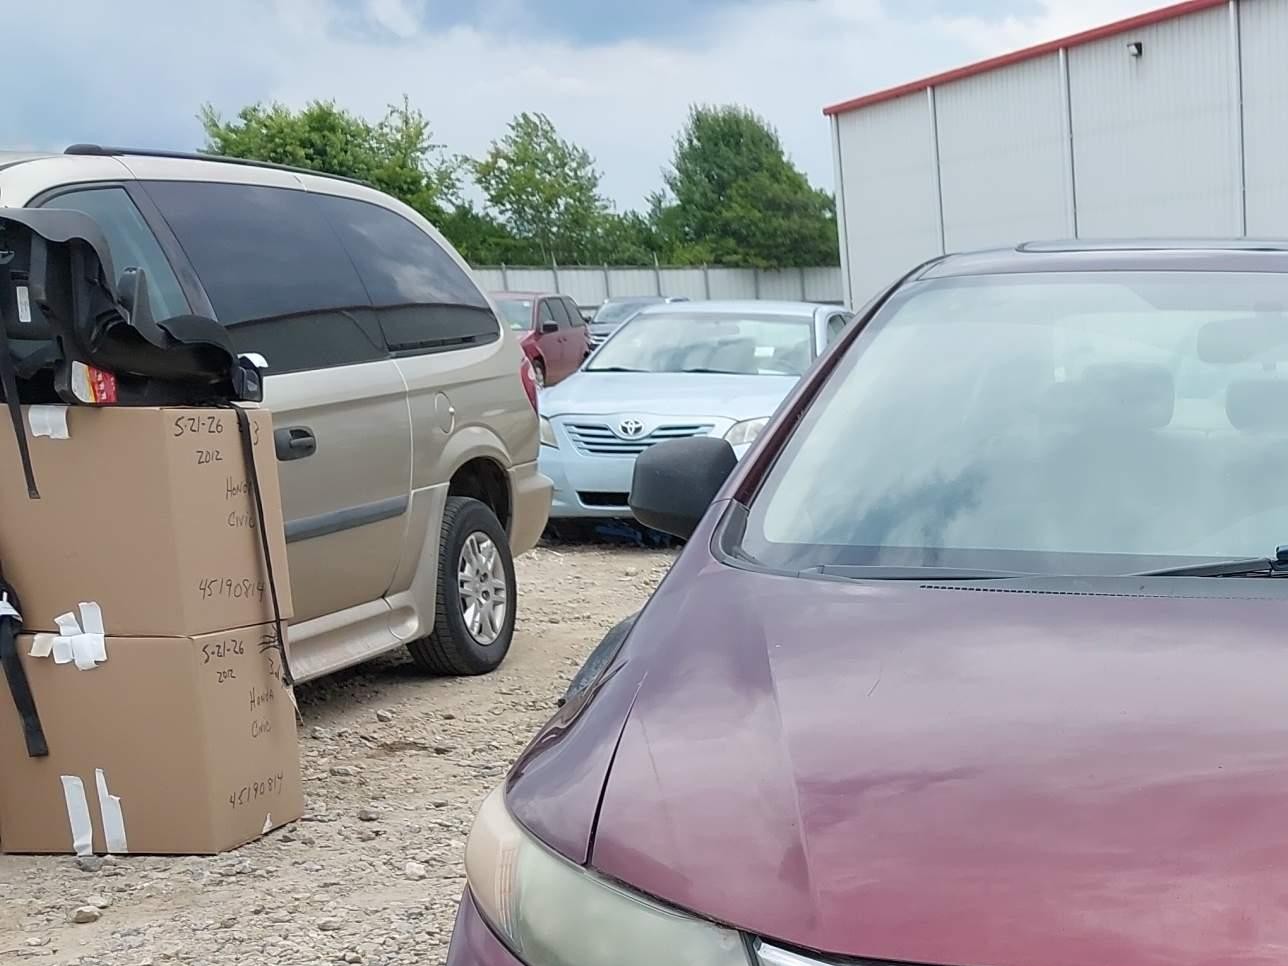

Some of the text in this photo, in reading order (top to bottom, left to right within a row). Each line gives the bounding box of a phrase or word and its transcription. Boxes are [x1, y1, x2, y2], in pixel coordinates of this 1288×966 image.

[195, 450, 223, 465] 2012
[199, 577, 266, 602] 45190814
[229, 771, 284, 809] 45190814
